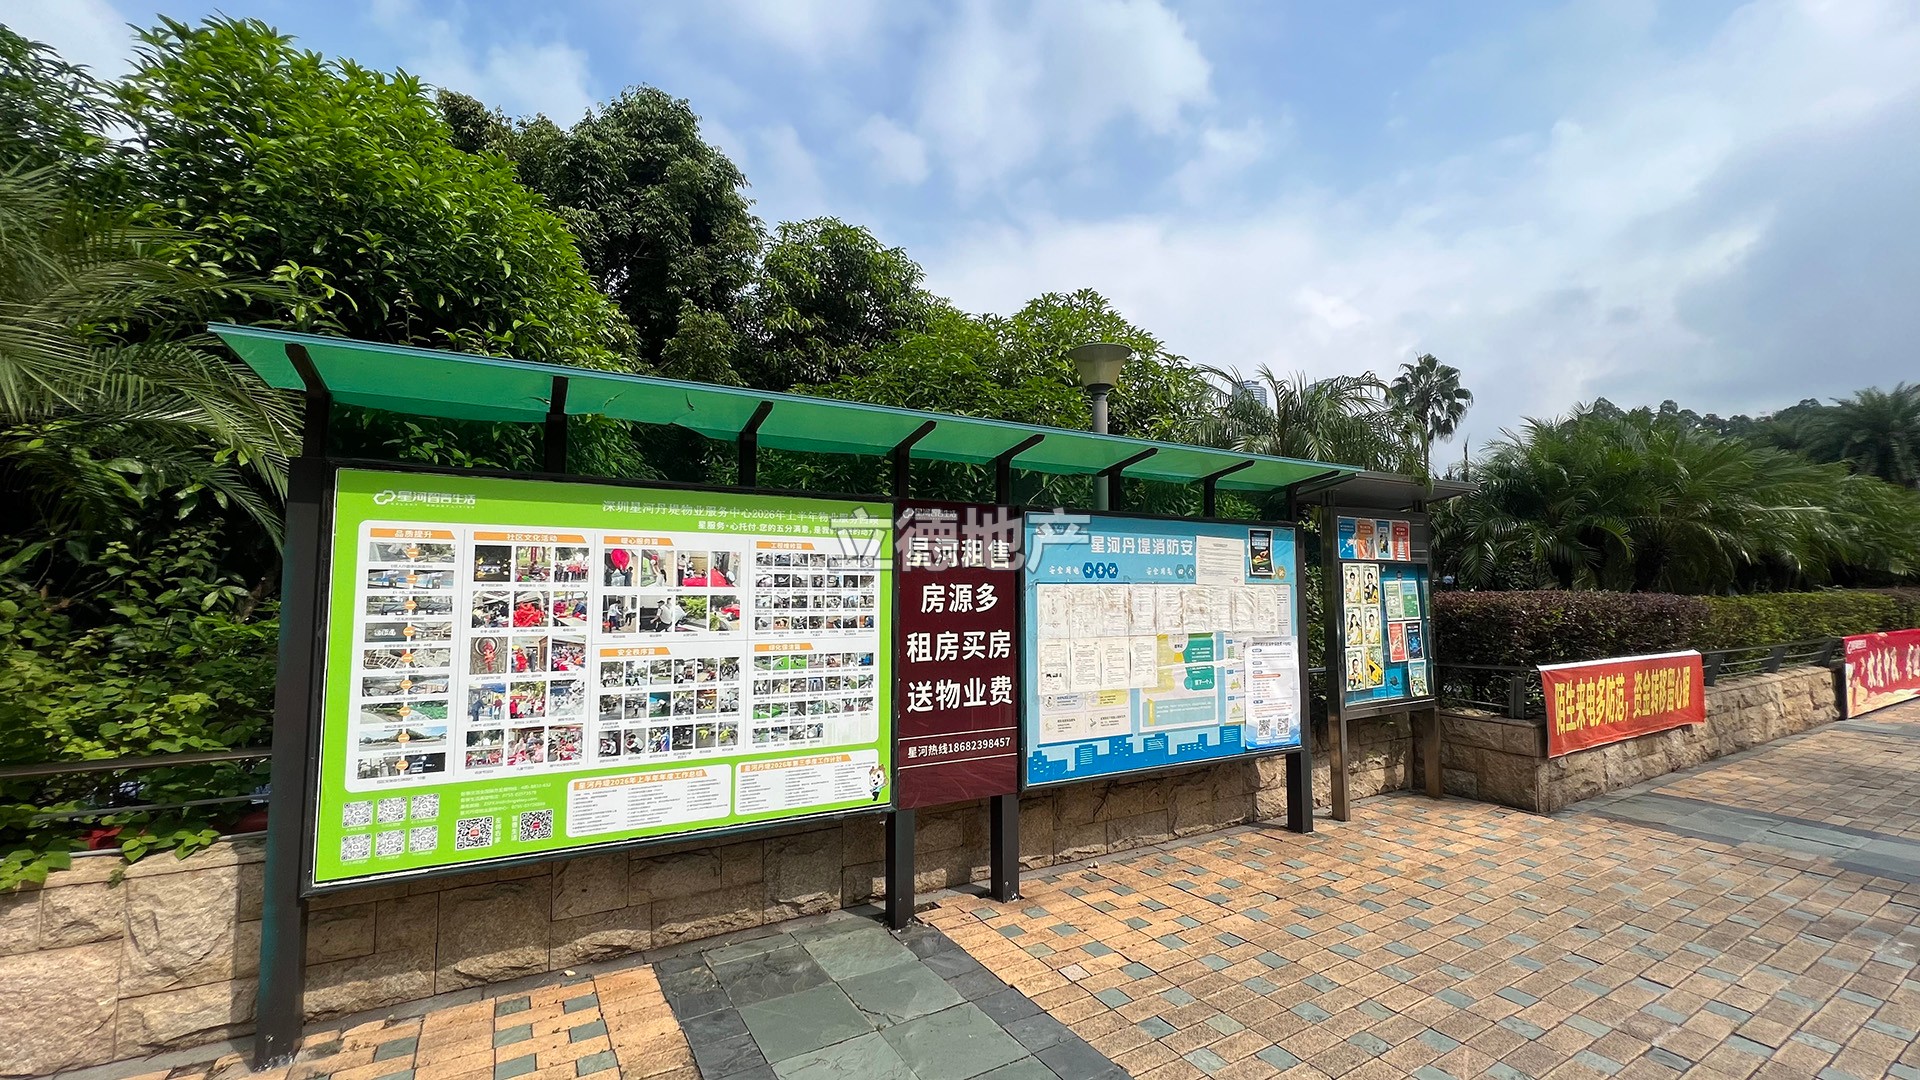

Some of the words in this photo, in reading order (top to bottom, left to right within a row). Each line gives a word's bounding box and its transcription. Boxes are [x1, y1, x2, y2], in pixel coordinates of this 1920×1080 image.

[395, 530, 433, 538] 品质提升
[506, 533, 558, 543] 社区文化活动
[1091, 535, 1194, 556] 星河丹堤消防安
[906, 537, 1010, 568] 星河租售
[920, 583, 999, 613] 房源多
[906, 629, 1012, 663] 租房买房
[906, 675, 1013, 713] 送物业费
[907, 737, 1011, 759] 星河热线18682398457
